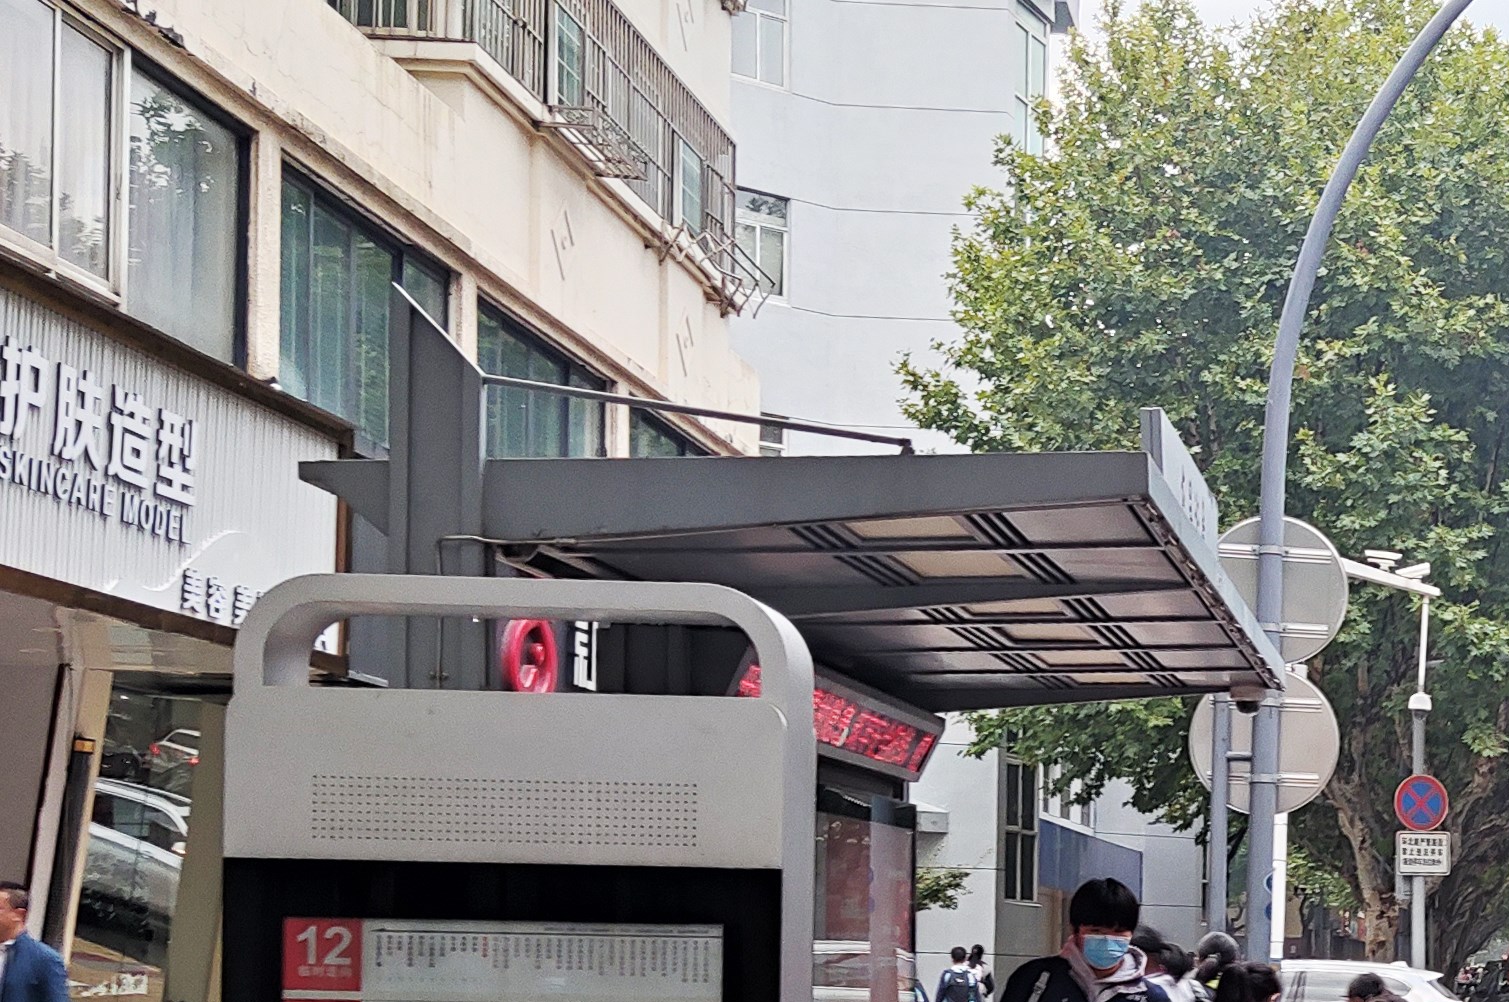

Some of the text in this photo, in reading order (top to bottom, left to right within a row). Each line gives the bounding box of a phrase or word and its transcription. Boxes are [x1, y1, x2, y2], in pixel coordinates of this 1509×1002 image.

[0, 335, 198, 506] 护肤造型
[0, 446, 193, 545] SKINCARE MODEL
[180, 567, 264, 625] 美容美
[297, 926, 352, 965] 12
